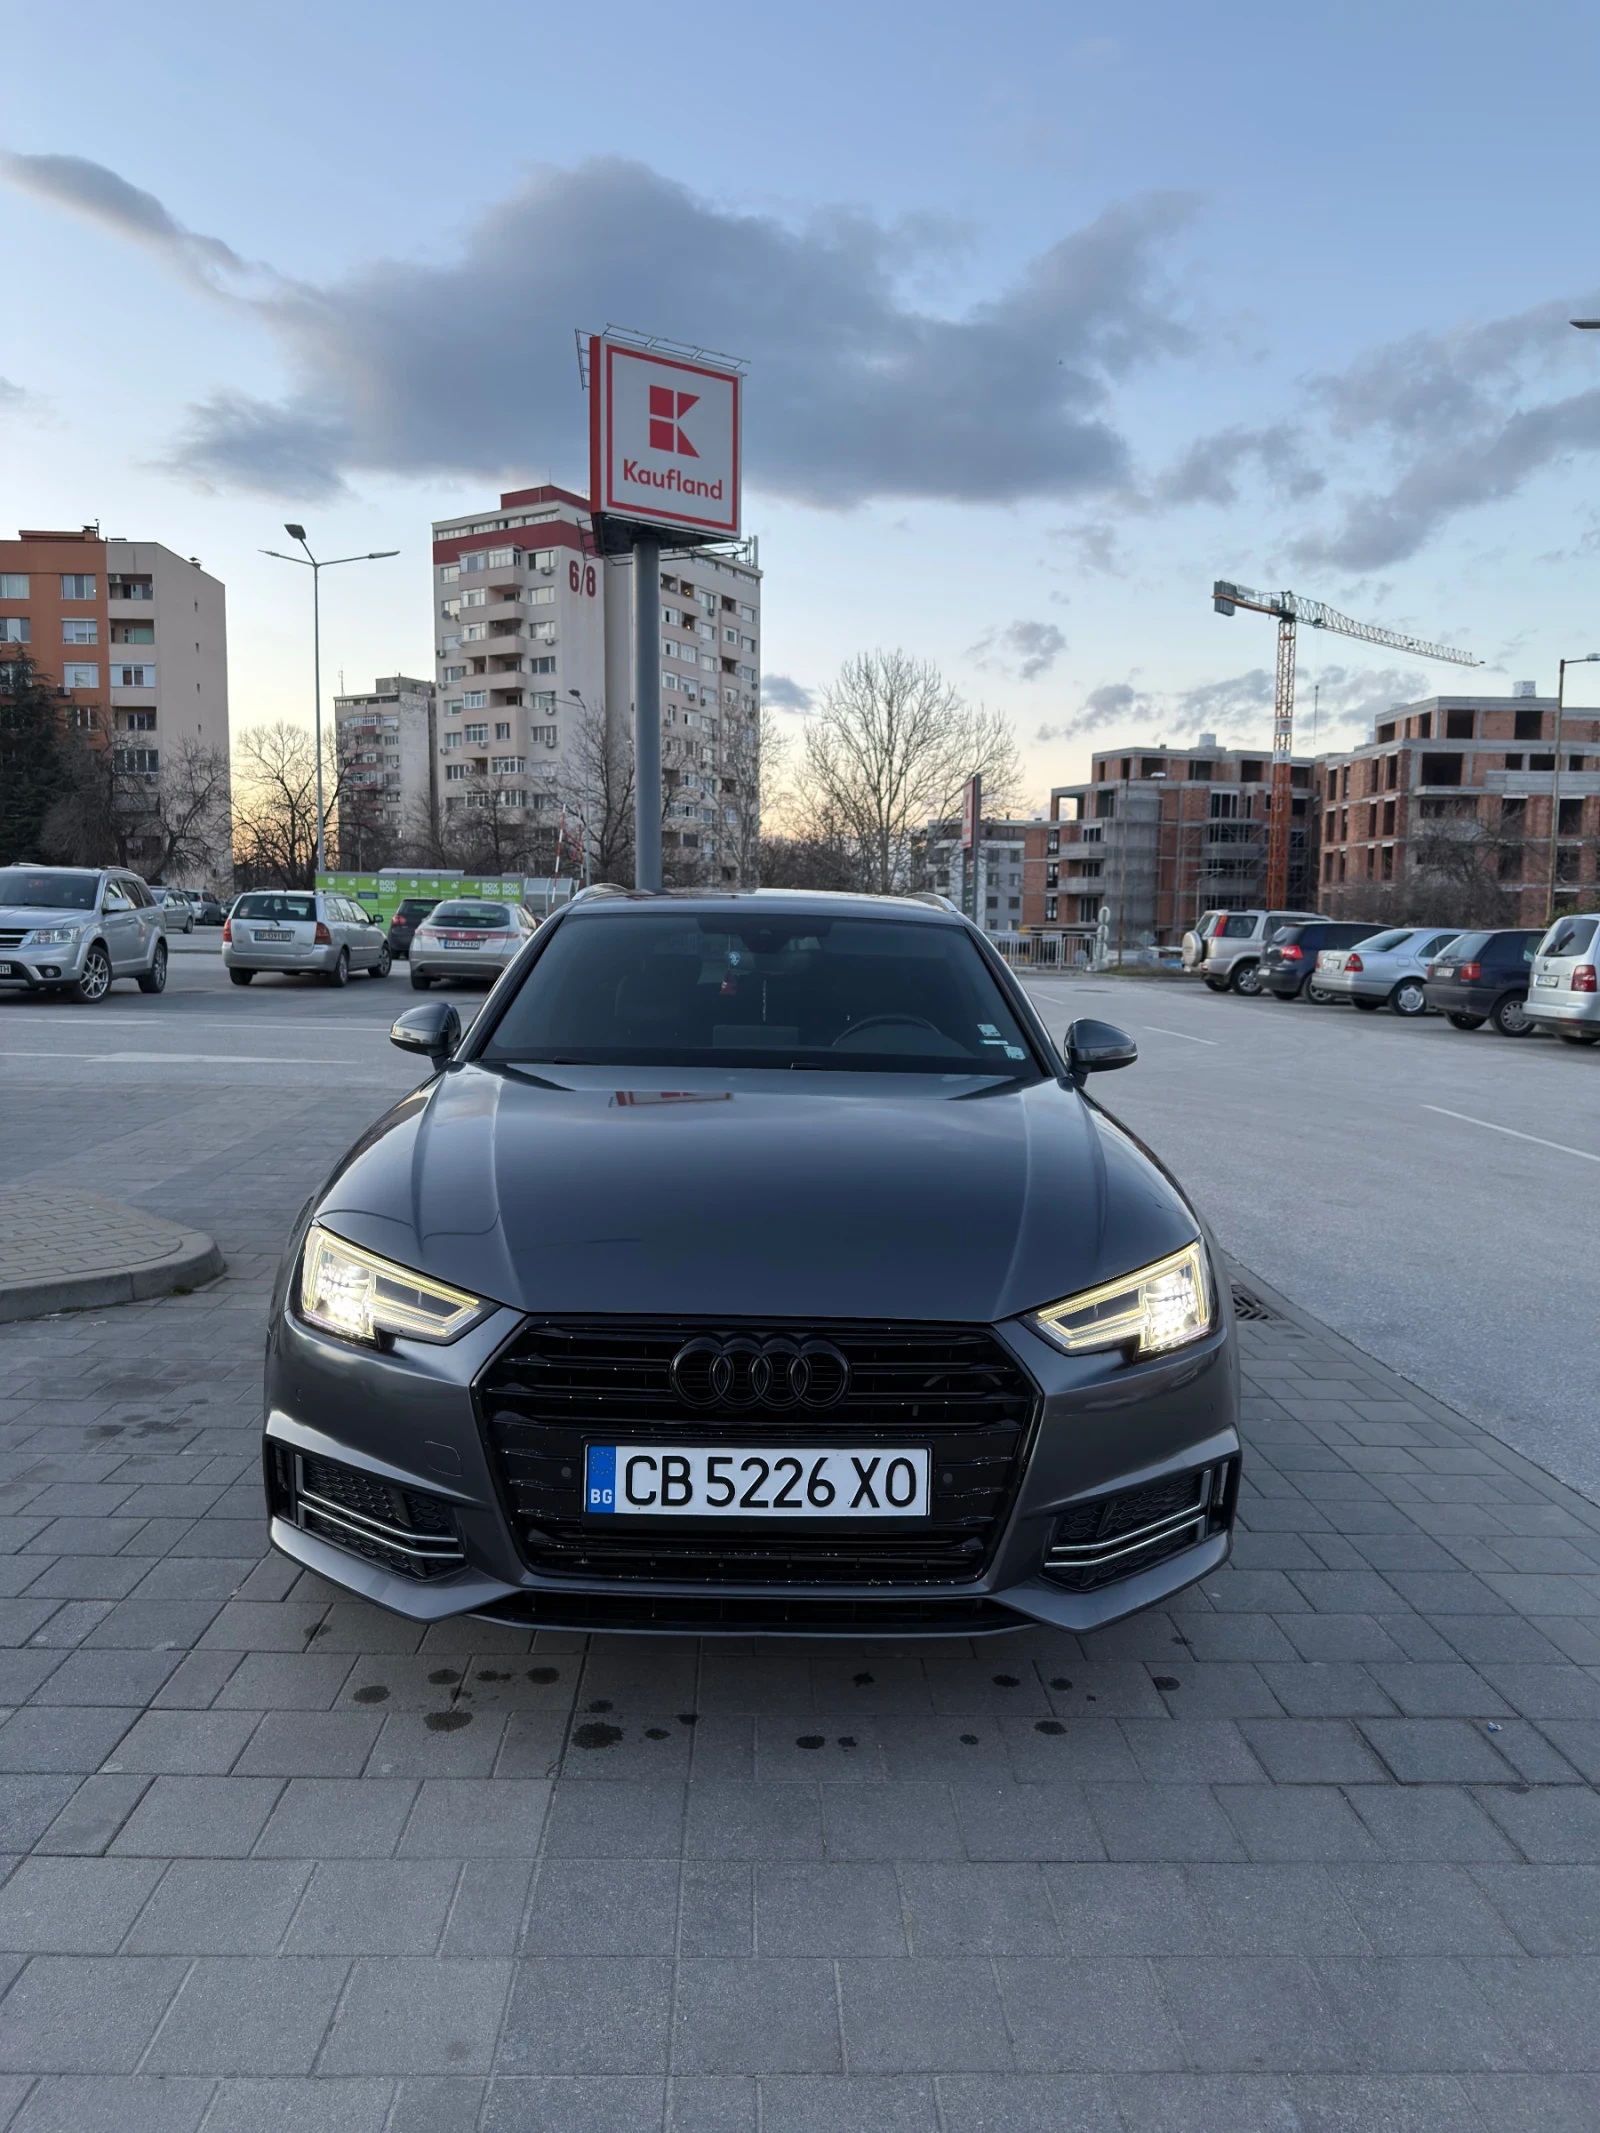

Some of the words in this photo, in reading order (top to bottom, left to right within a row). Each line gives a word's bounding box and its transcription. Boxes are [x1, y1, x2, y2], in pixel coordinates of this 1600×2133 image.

[623, 458, 723, 501] Kaufland
[569, 560, 596, 598] 6/8
[590, 1488, 613, 1504] BG
[625, 1455, 693, 1506] CB
[706, 1456, 836, 1508] 5226
